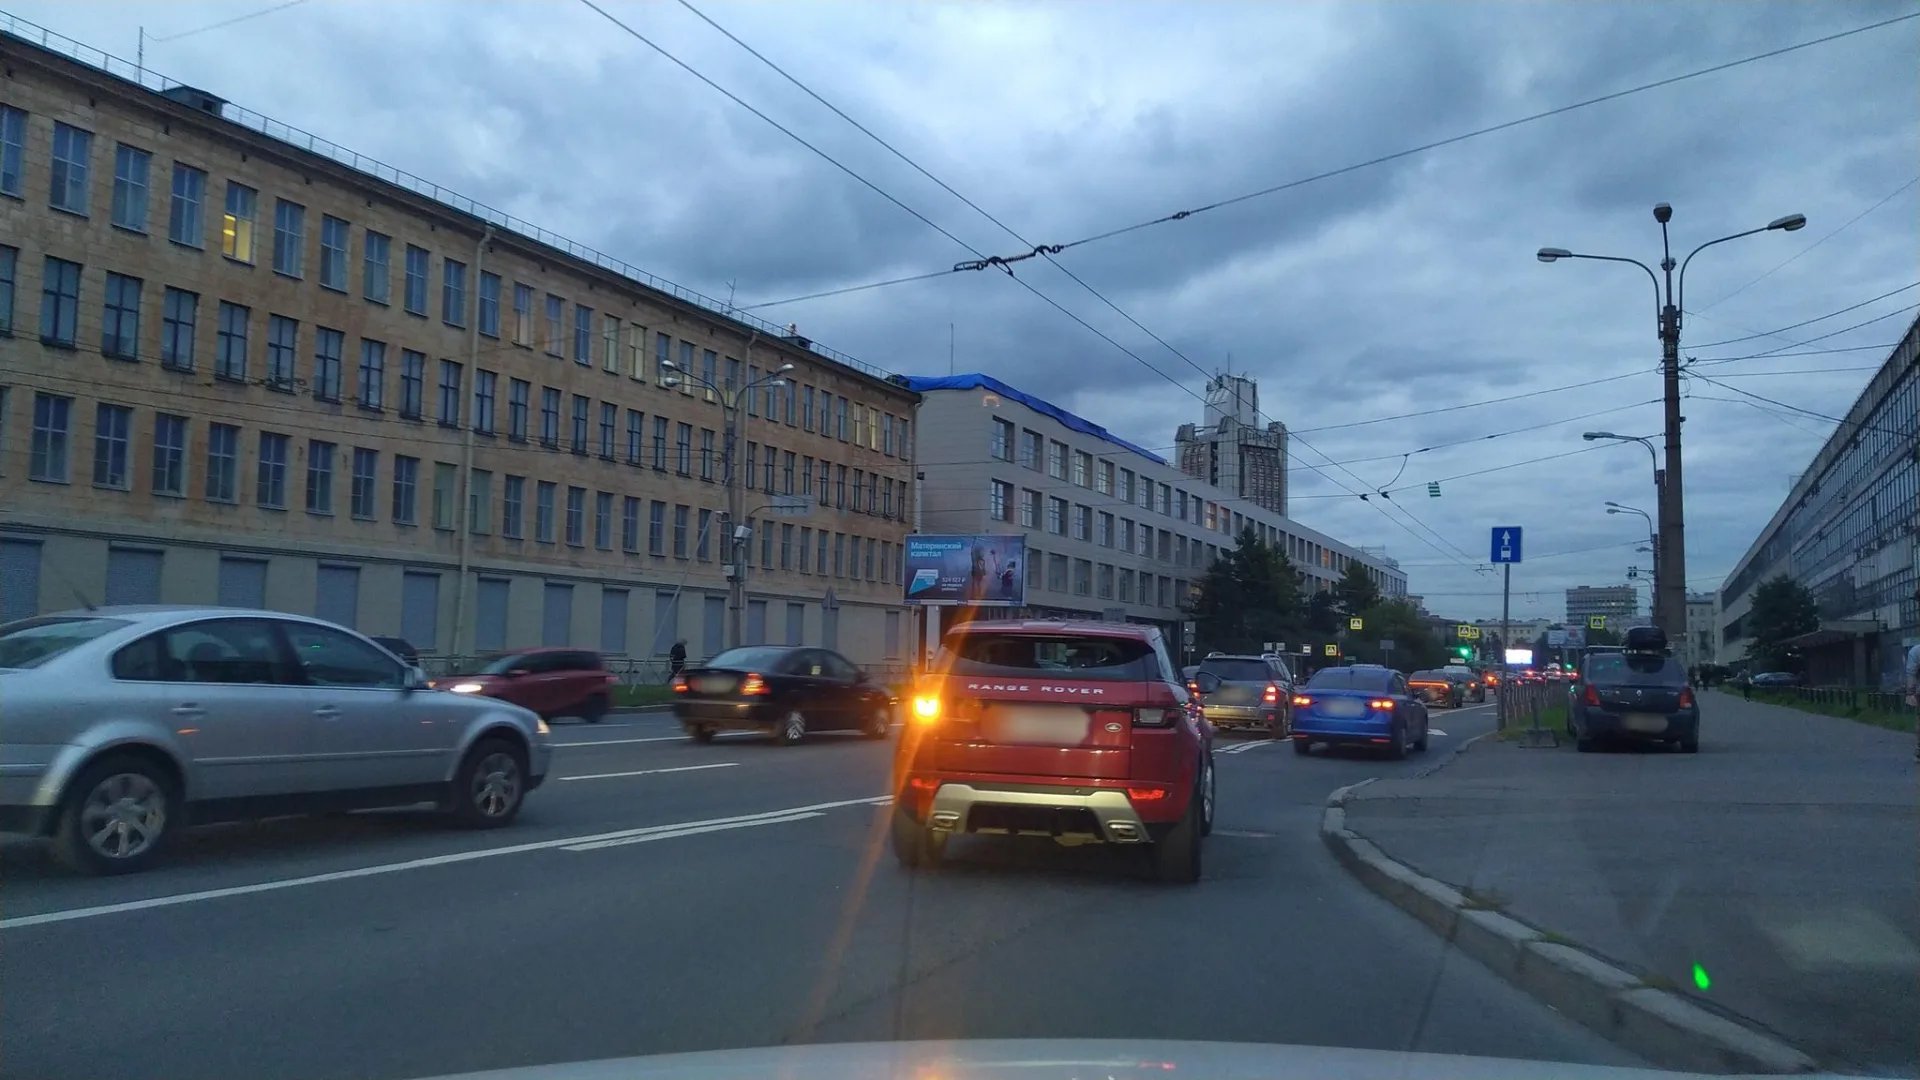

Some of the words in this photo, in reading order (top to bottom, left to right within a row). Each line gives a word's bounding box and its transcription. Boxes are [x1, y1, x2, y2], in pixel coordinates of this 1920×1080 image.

[910, 541, 962, 551] Материнский
[967, 683, 1030, 692] RANGE
[1040, 685, 1104, 695] ROVER
